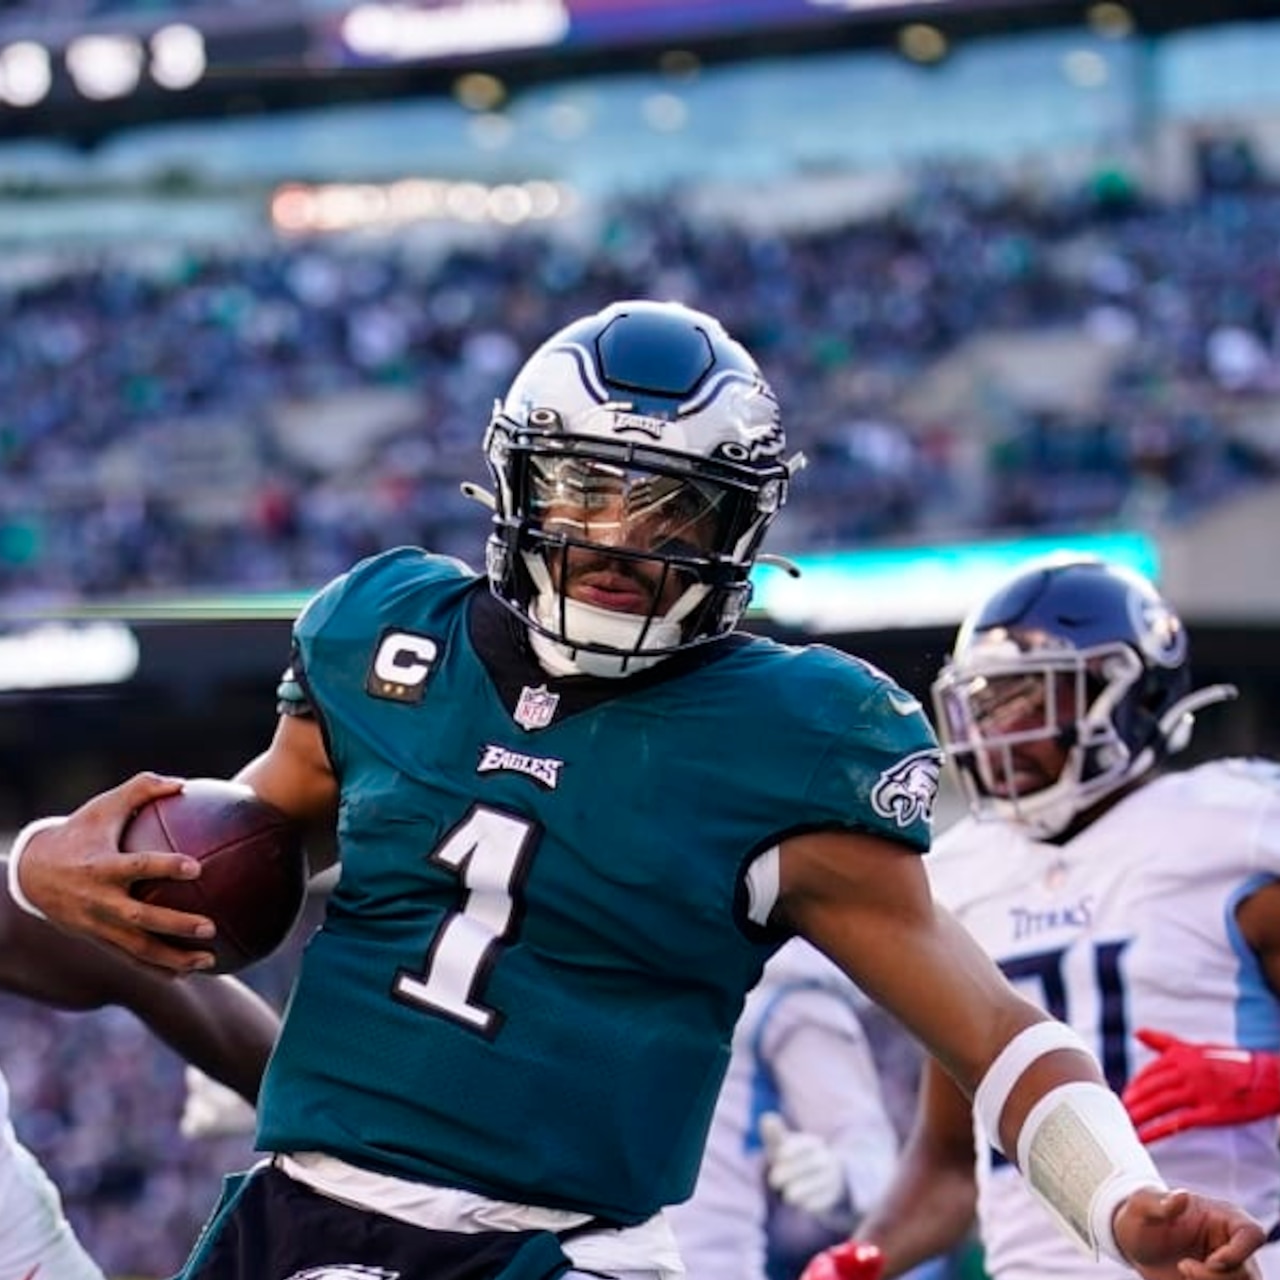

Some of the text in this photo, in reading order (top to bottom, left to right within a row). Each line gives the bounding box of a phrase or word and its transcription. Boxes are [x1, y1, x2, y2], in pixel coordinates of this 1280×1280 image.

[375, 633, 437, 686] C
[476, 743, 565, 789] EAGLES
[395, 804, 538, 1034] 1
